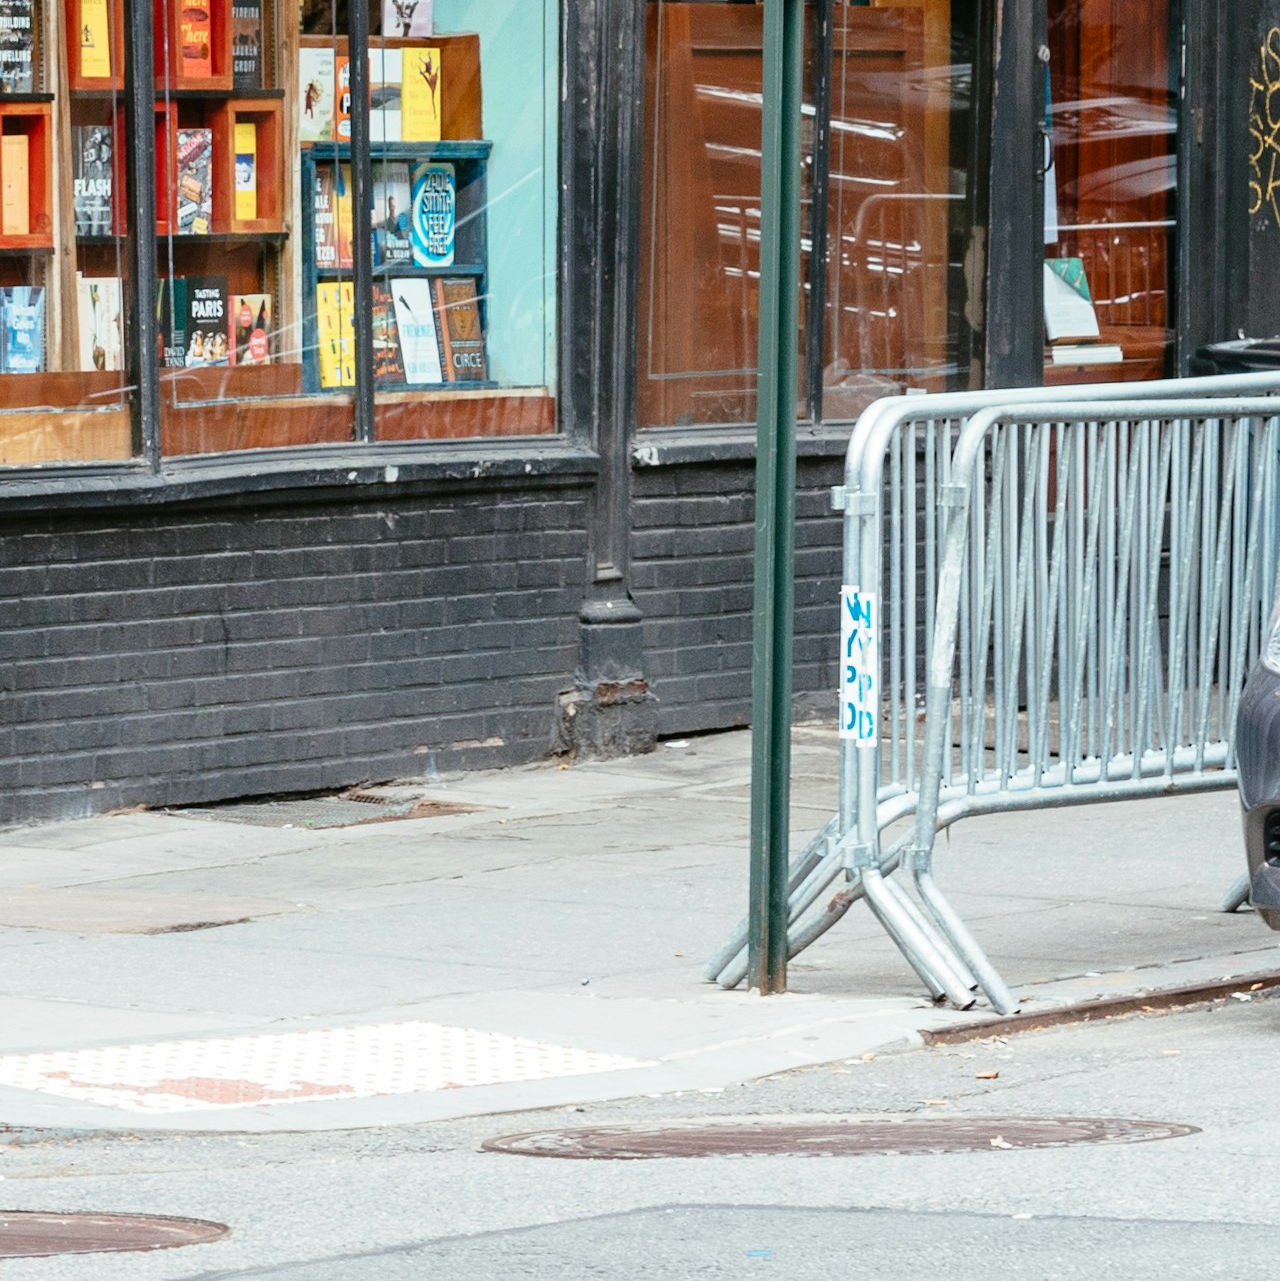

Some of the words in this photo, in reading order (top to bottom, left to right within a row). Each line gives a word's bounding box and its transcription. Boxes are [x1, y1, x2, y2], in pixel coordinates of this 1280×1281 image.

[233, 59, 256, 73] GROFF
[73, 178, 112, 197] FLASH
[422, 194, 452, 214] SMITH
[194, 288, 220, 299] TASTING
[191, 300, 223, 318] PARIS
[452, 352, 483, 369] CIRCE
